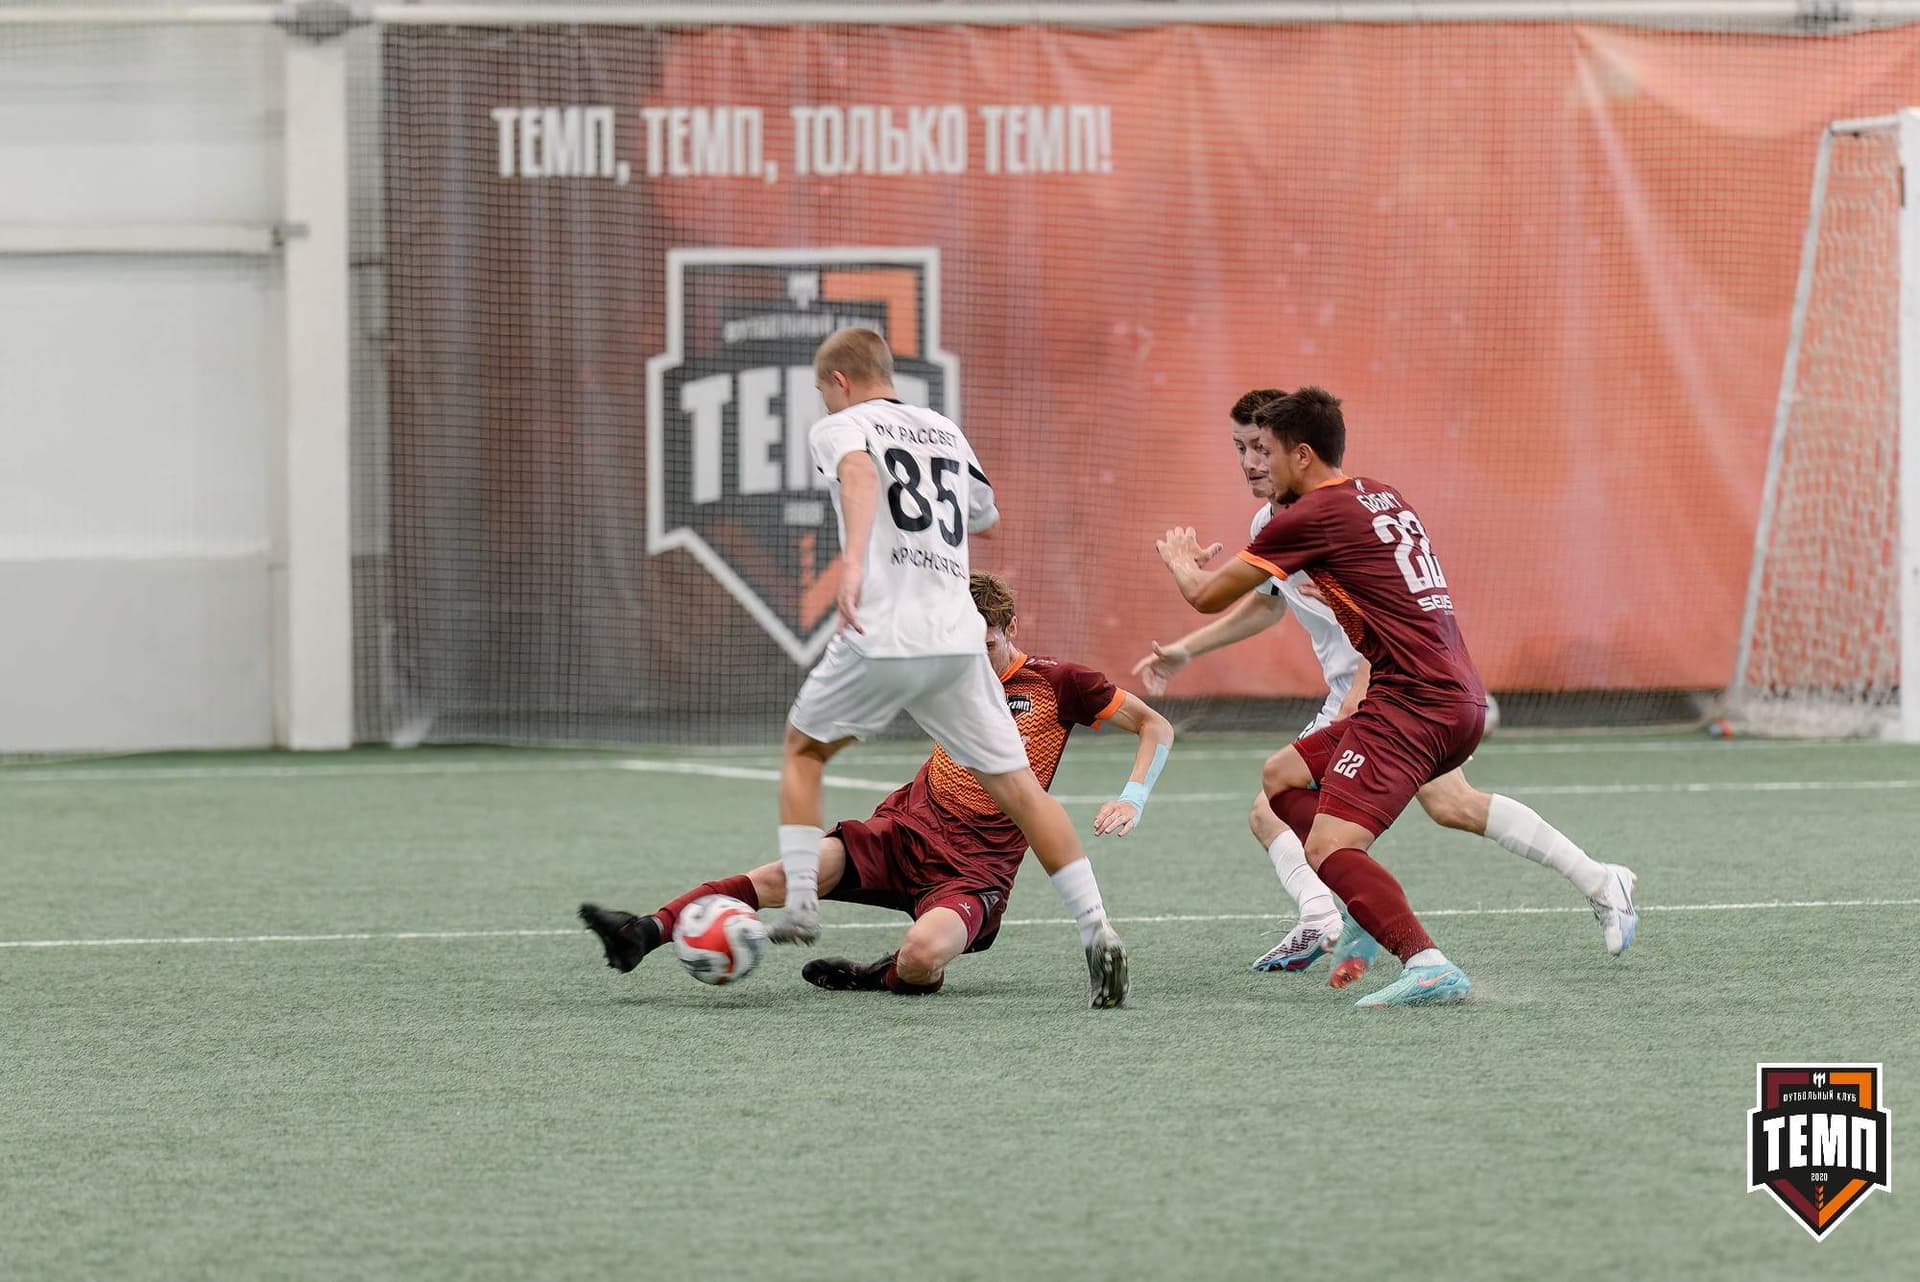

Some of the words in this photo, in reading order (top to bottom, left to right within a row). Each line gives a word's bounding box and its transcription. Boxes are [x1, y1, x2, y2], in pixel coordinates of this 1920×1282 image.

[491, 105, 630, 186] ТЕМП,
[640, 105, 778, 185] ТЕМП,
[790, 104, 968, 175] ТОЛЬКО
[979, 104, 1114, 174] ТЕМП!
[884, 447, 964, 548] 85
[1371, 509, 1449, 595] 22
[1333, 749, 1366, 779] 22
